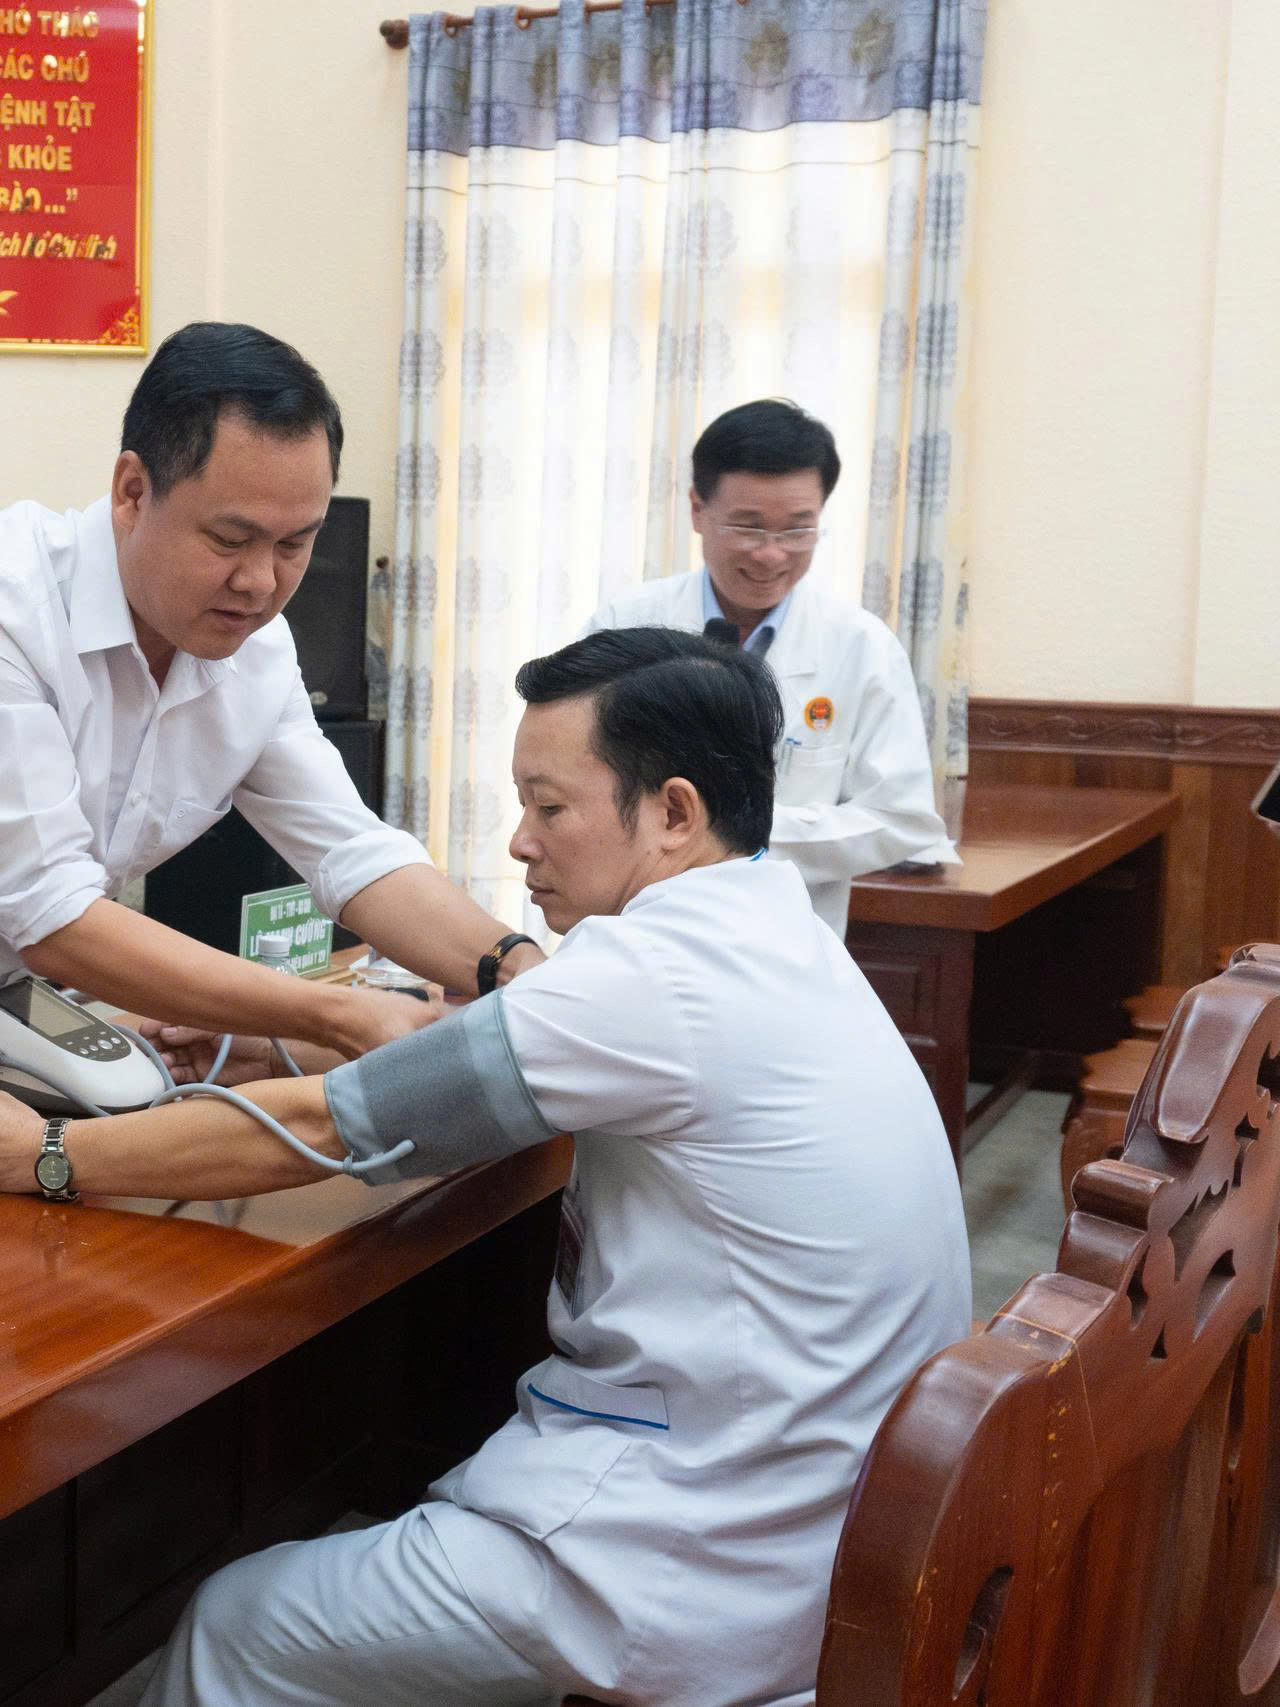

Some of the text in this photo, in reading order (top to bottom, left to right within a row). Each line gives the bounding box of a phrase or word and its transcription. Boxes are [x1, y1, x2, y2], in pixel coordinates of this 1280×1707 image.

[41, 51, 90, 83] CHÚ
[54, 95, 96, 133] TẬT
[8, 134, 72, 171] KHỎE
